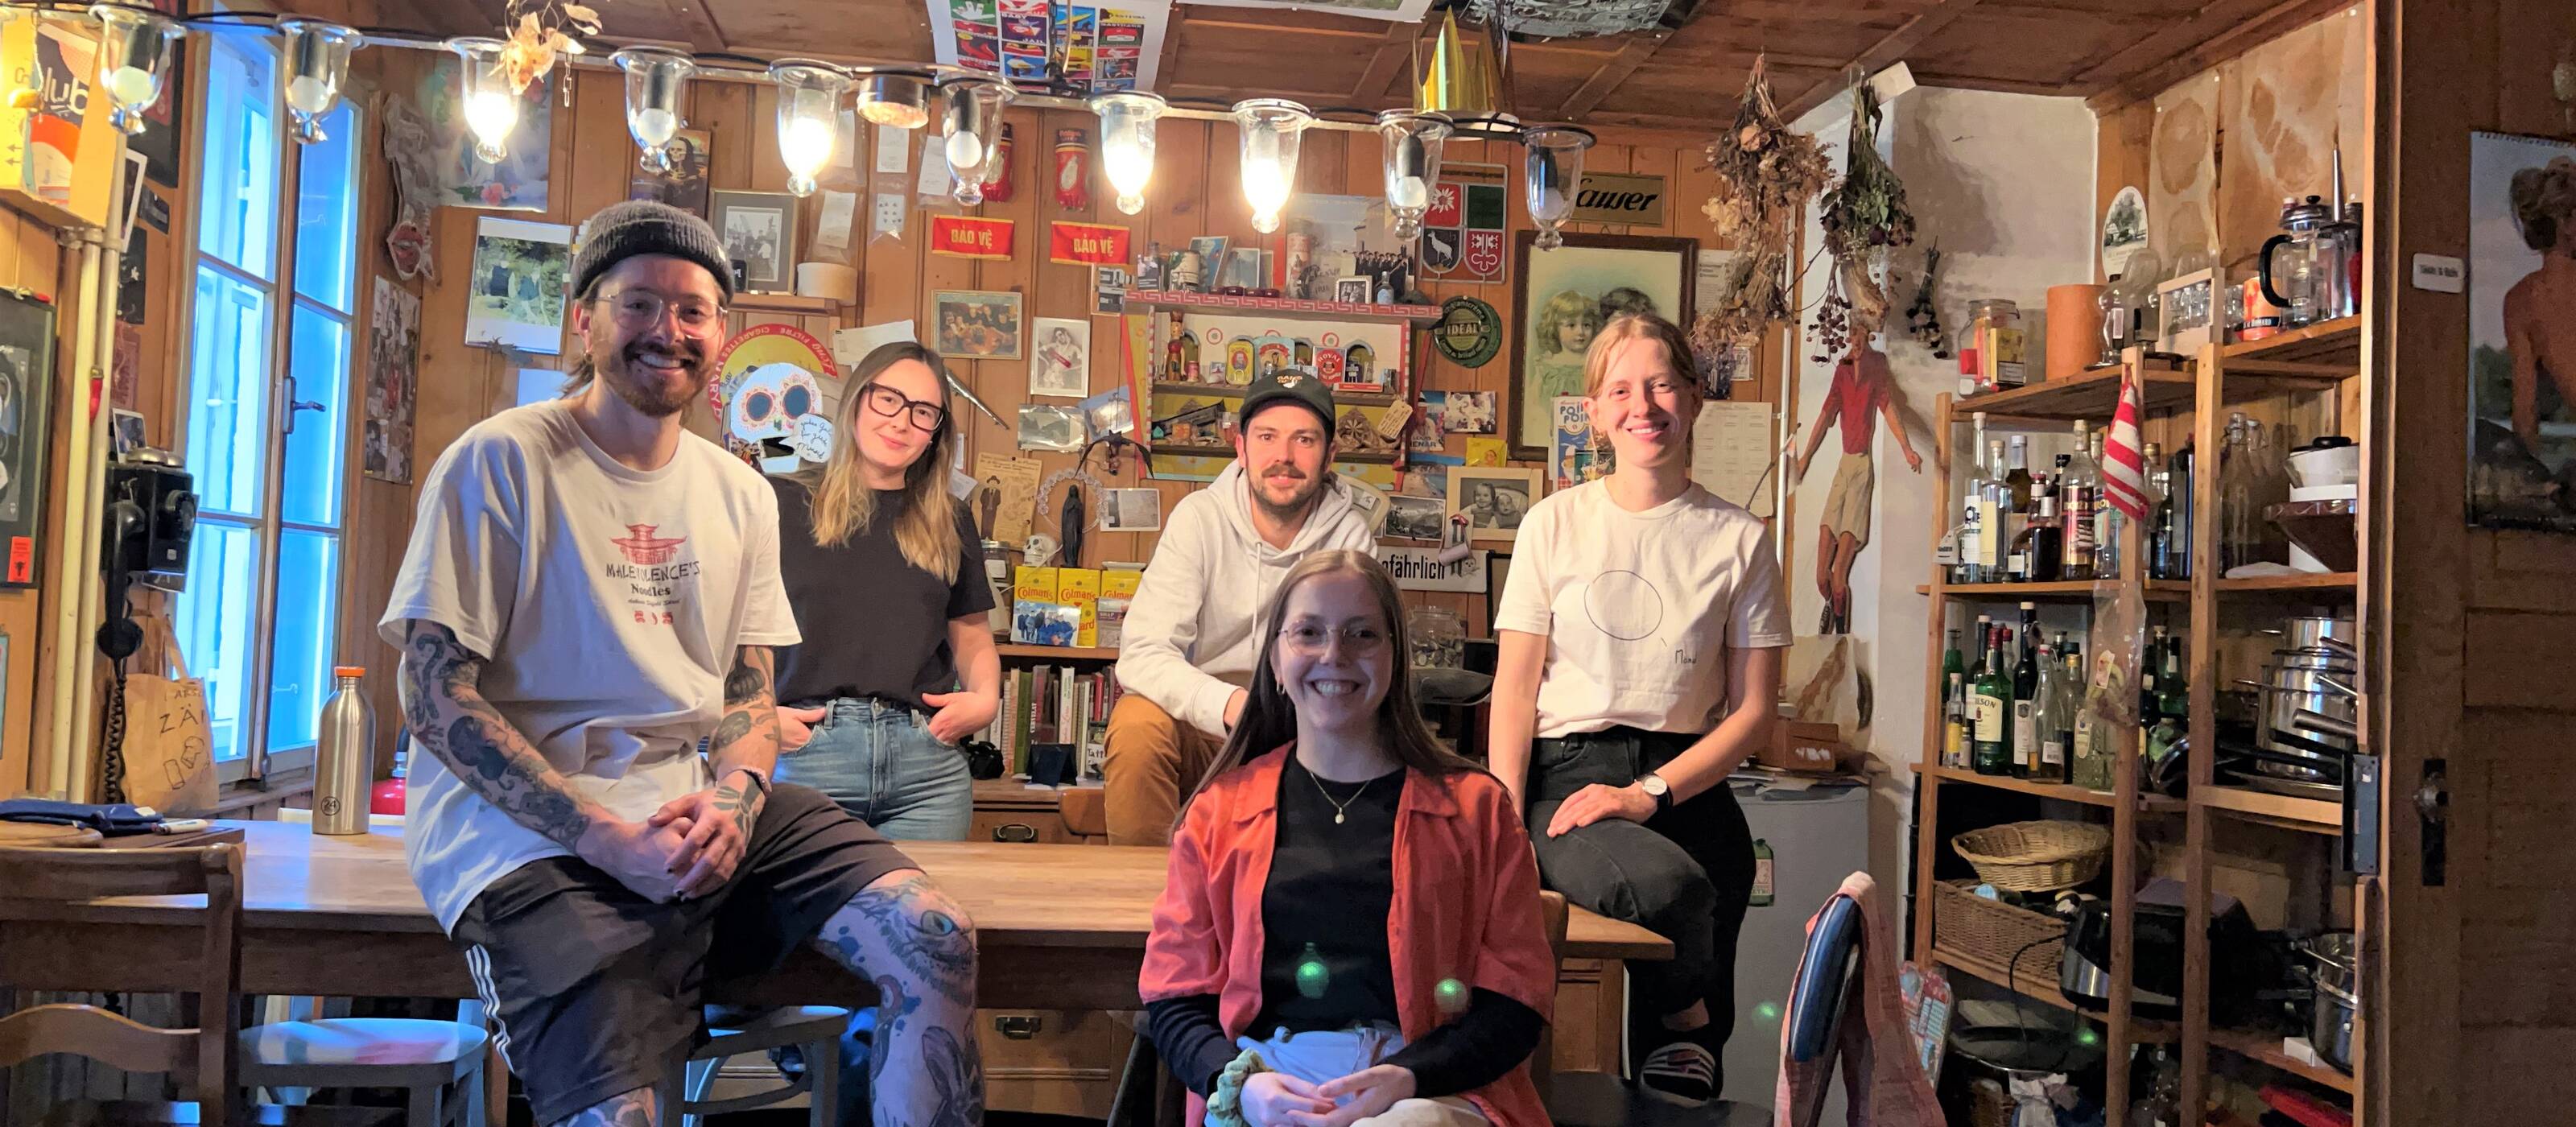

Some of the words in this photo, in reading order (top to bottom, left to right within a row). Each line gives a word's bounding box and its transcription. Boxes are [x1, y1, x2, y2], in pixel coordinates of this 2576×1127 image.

[43, 66, 89, 116] lub
[1447, 322, 1479, 336] IDEAL
[721, 326, 770, 358] CIGARETTES
[606, 561, 700, 582] MALEVOLENCE'S
[630, 583, 671, 597] Noodles
[1017, 586, 1054, 601] Colman's
[1060, 588, 1096, 602] Colman's
[1104, 590, 1134, 600] Colman
[1080, 619, 1096, 631] ard
[1088, 747, 1104, 759] Tatt
